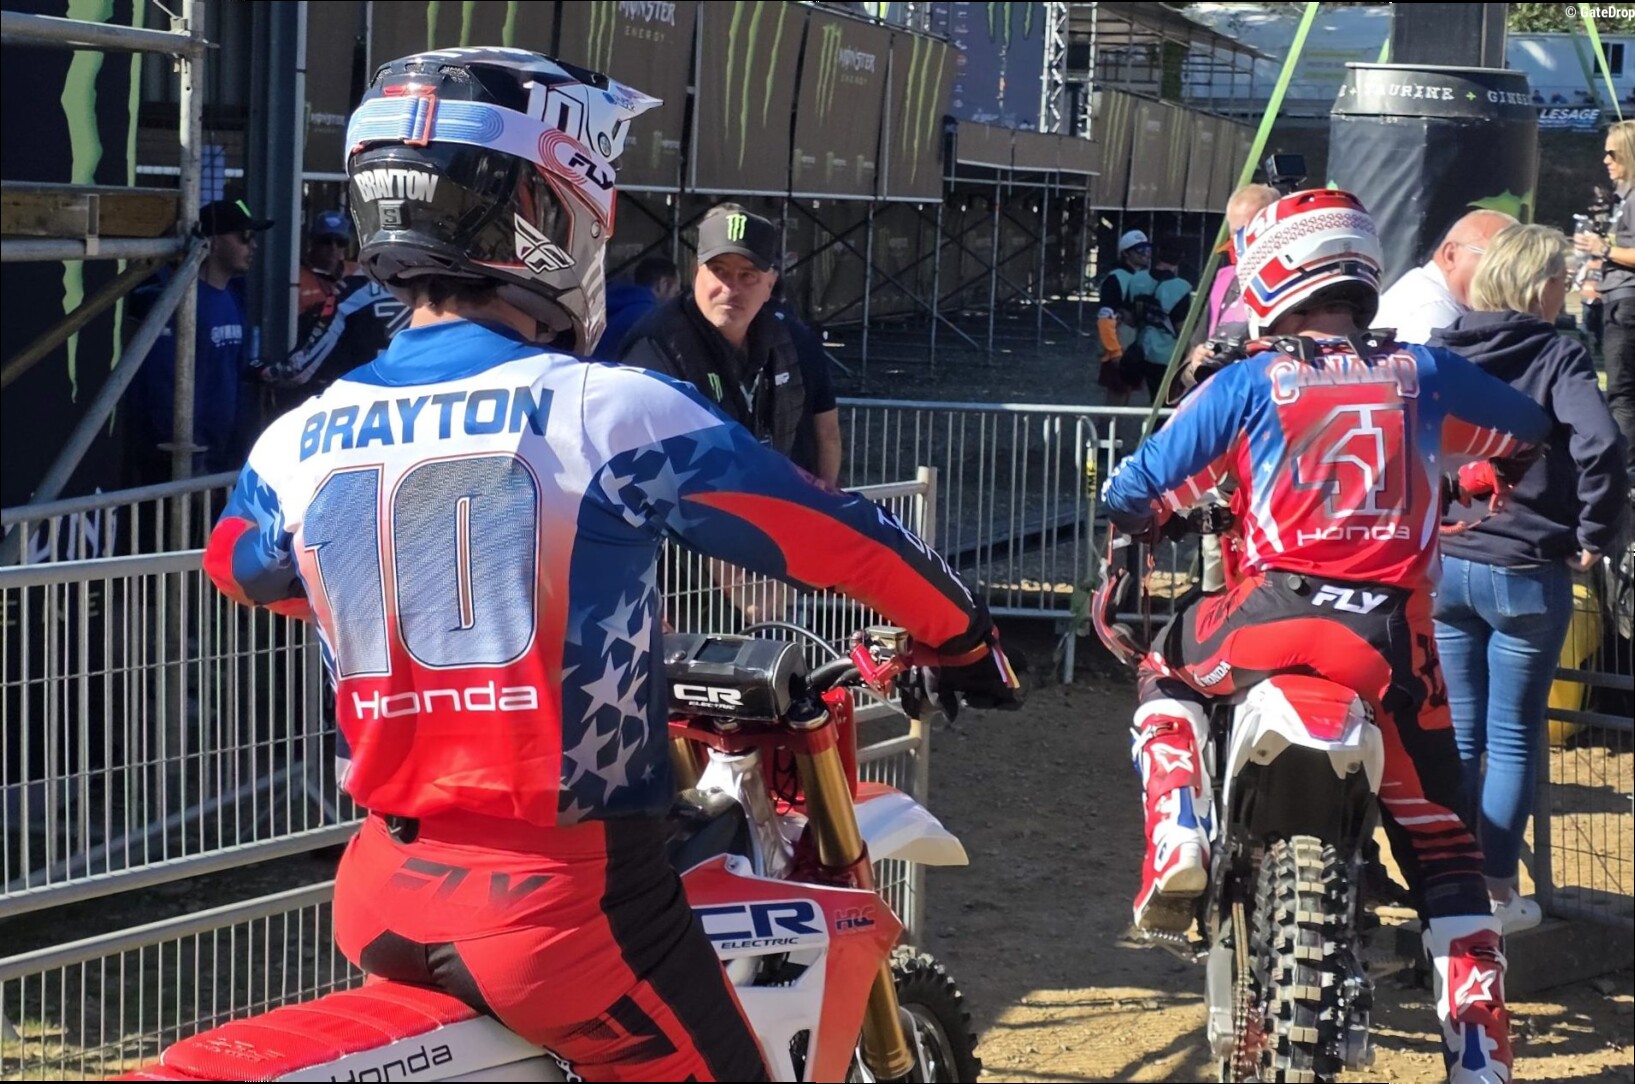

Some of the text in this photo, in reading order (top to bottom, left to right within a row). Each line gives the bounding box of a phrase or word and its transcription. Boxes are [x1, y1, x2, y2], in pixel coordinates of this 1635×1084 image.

[1540, 108, 1600, 120] LESAGE
[354, 168, 439, 203] BRAYTON
[568, 152, 613, 190] FLY
[300, 386, 554, 462] BRAYTON
[1297, 525, 1410, 546] Honda
[303, 451, 542, 680] 10
[1311, 585, 1388, 614] FLY
[352, 681, 538, 720] Honda
[673, 683, 744, 706] CR
[688, 700, 736, 710] ELECTRIC
[699, 901, 823, 941] CR
[721, 937, 799, 949] ELECTRIC
